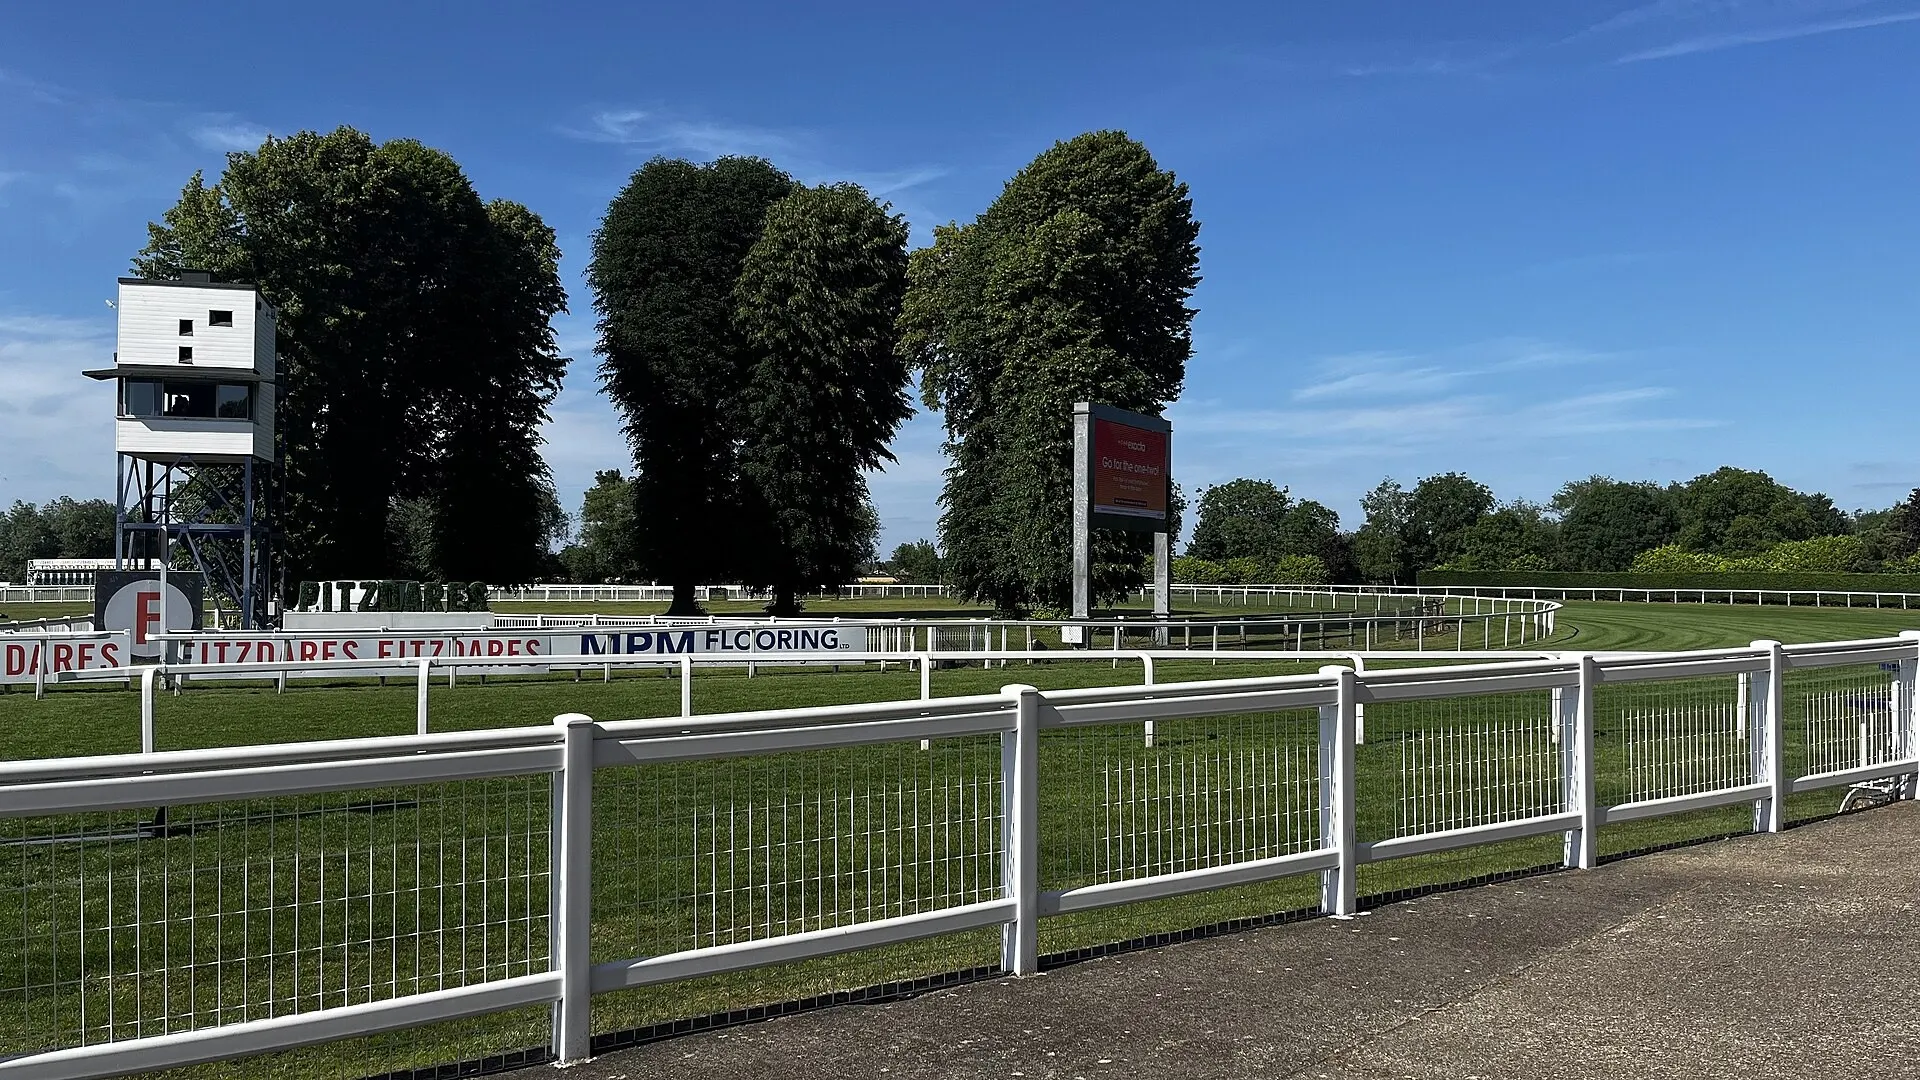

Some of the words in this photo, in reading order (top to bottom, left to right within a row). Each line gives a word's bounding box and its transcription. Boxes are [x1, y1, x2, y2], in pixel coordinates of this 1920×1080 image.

[1102, 456, 1113, 468] Go
[1113, 459, 1122, 470] for
[1123, 461, 1133, 472] the
[136, 592, 161, 645] F
[6, 643, 120, 676] DARES
[378, 639, 541, 665] FITZDARES
[580, 631, 695, 664] MPM
[705, 629, 838, 650] FLOORING
